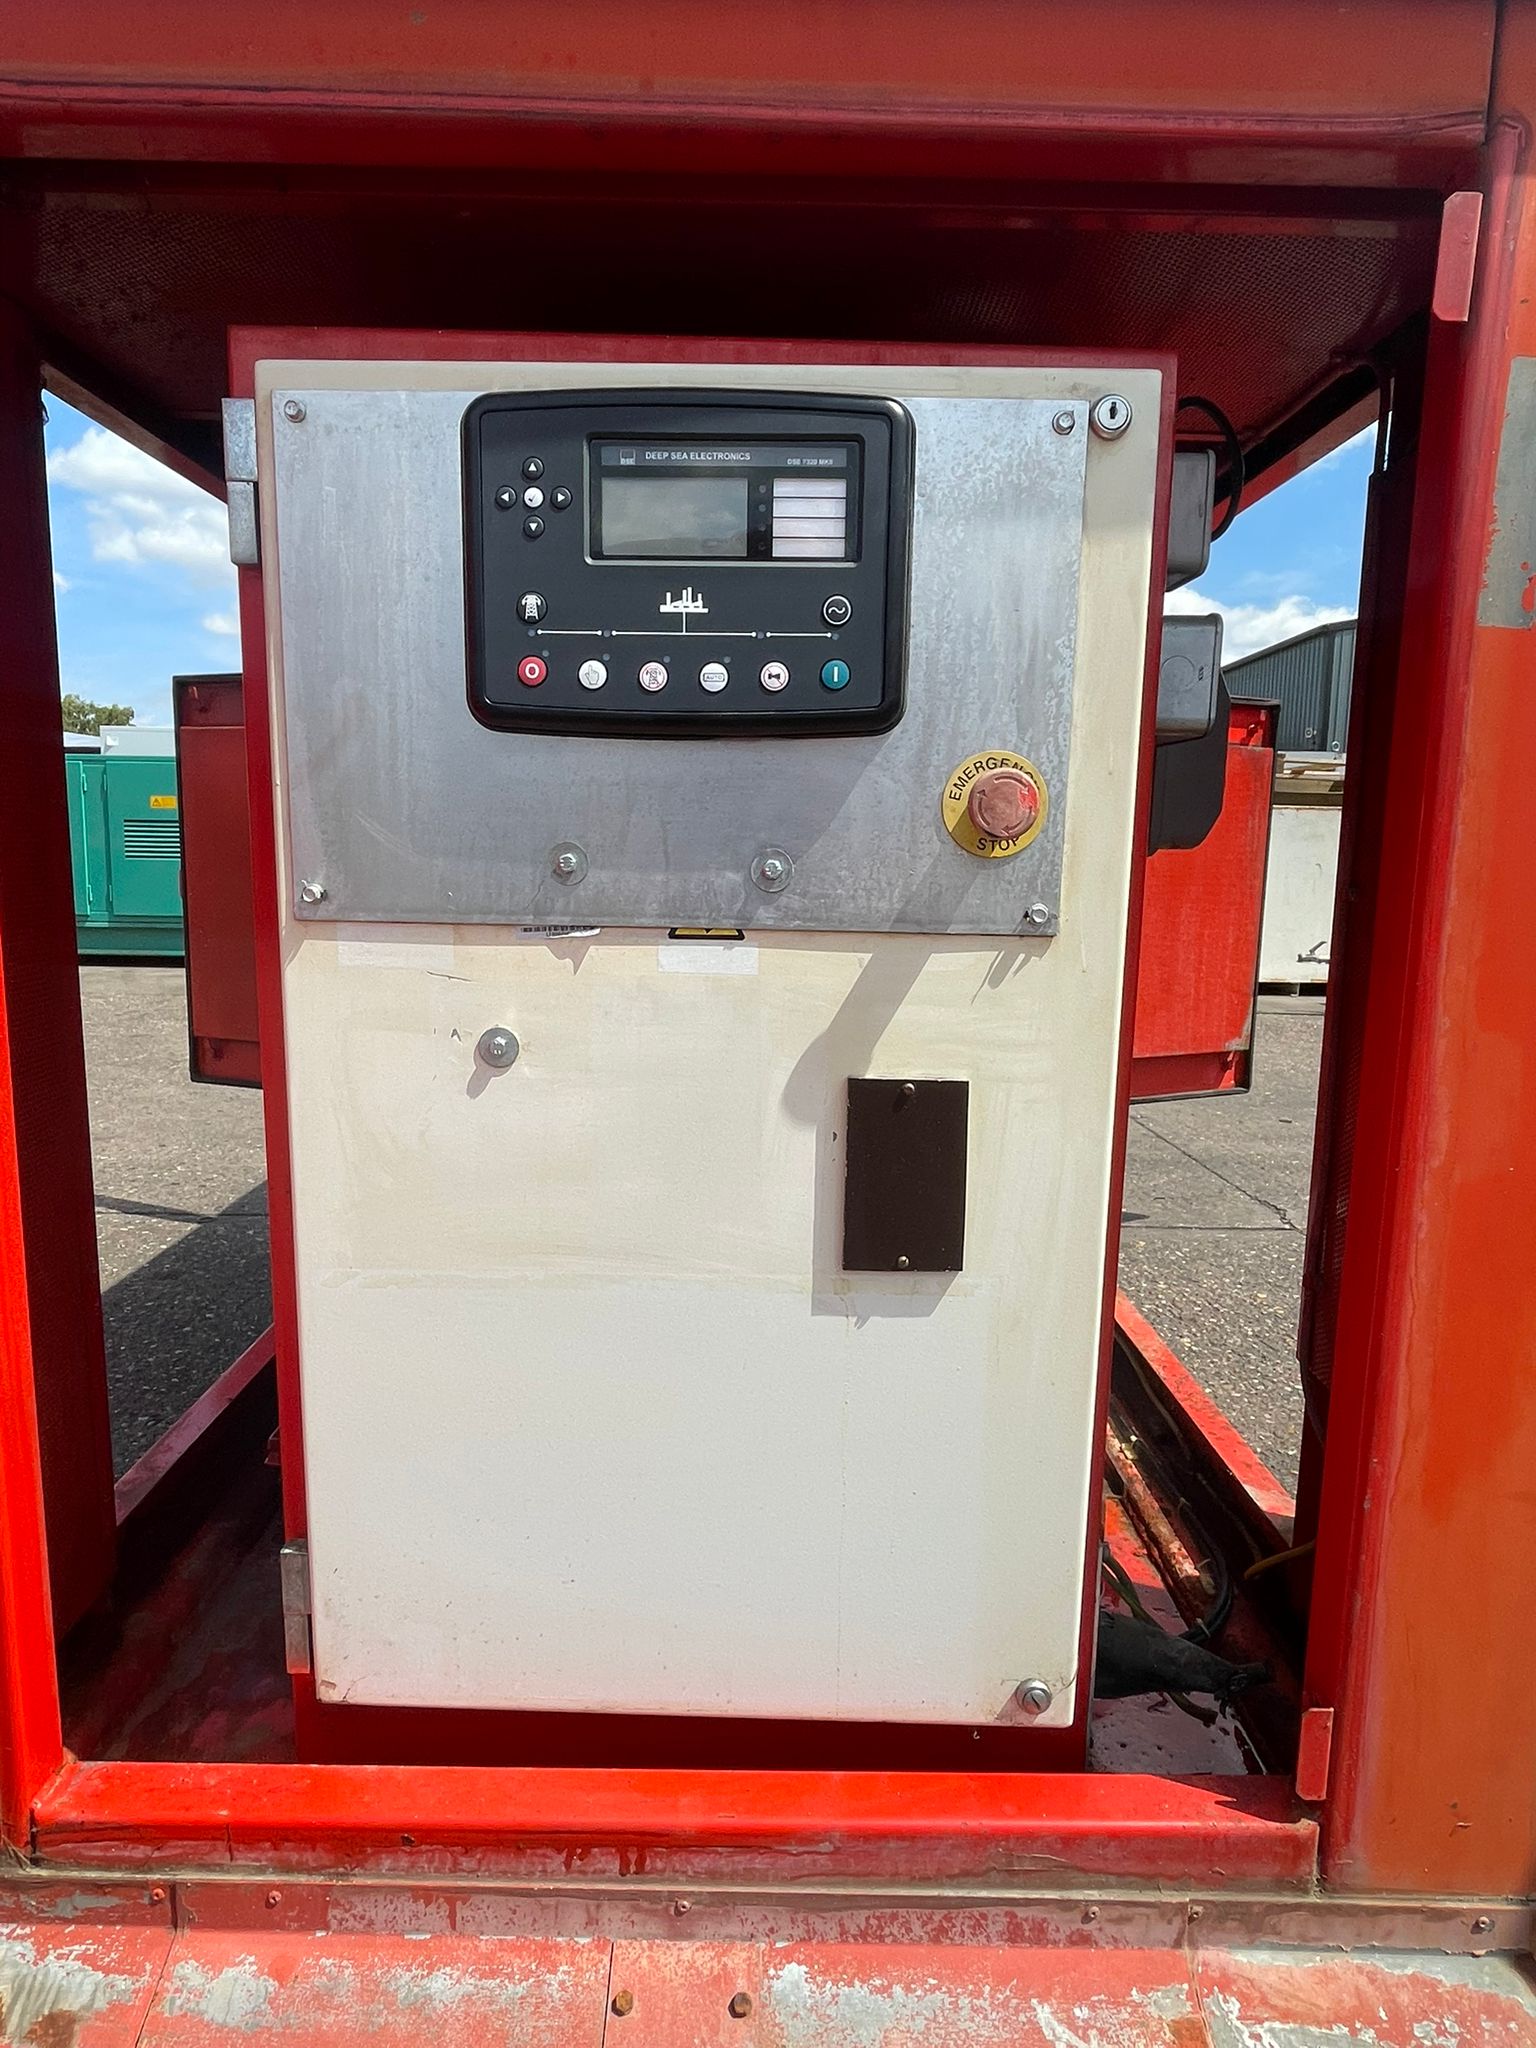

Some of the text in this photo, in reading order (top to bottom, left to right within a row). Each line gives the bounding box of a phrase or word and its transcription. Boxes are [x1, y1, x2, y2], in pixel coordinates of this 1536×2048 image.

[645, 451, 751, 461] DEEP SEA ELECTRONICS
